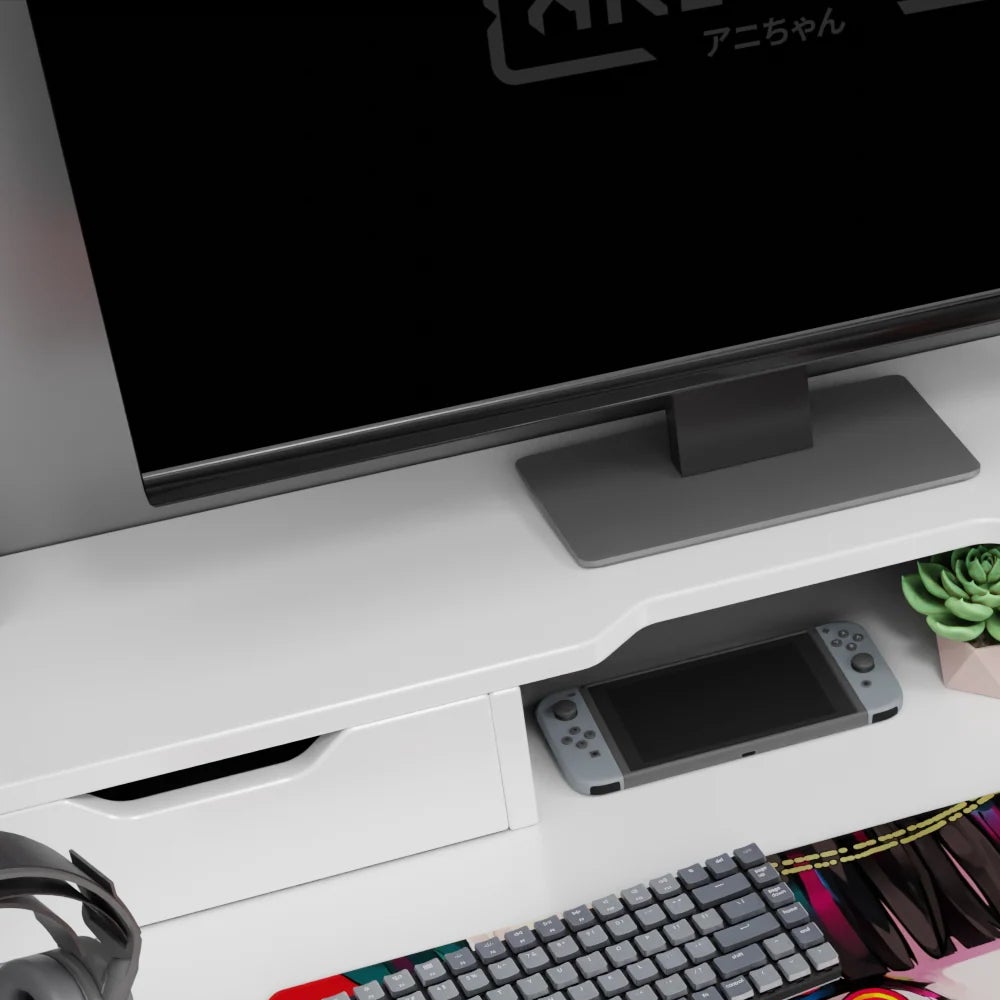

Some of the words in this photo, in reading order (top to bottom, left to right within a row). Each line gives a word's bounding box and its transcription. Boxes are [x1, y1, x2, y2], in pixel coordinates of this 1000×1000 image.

[703, 8, 846, 57] アニちゃん
